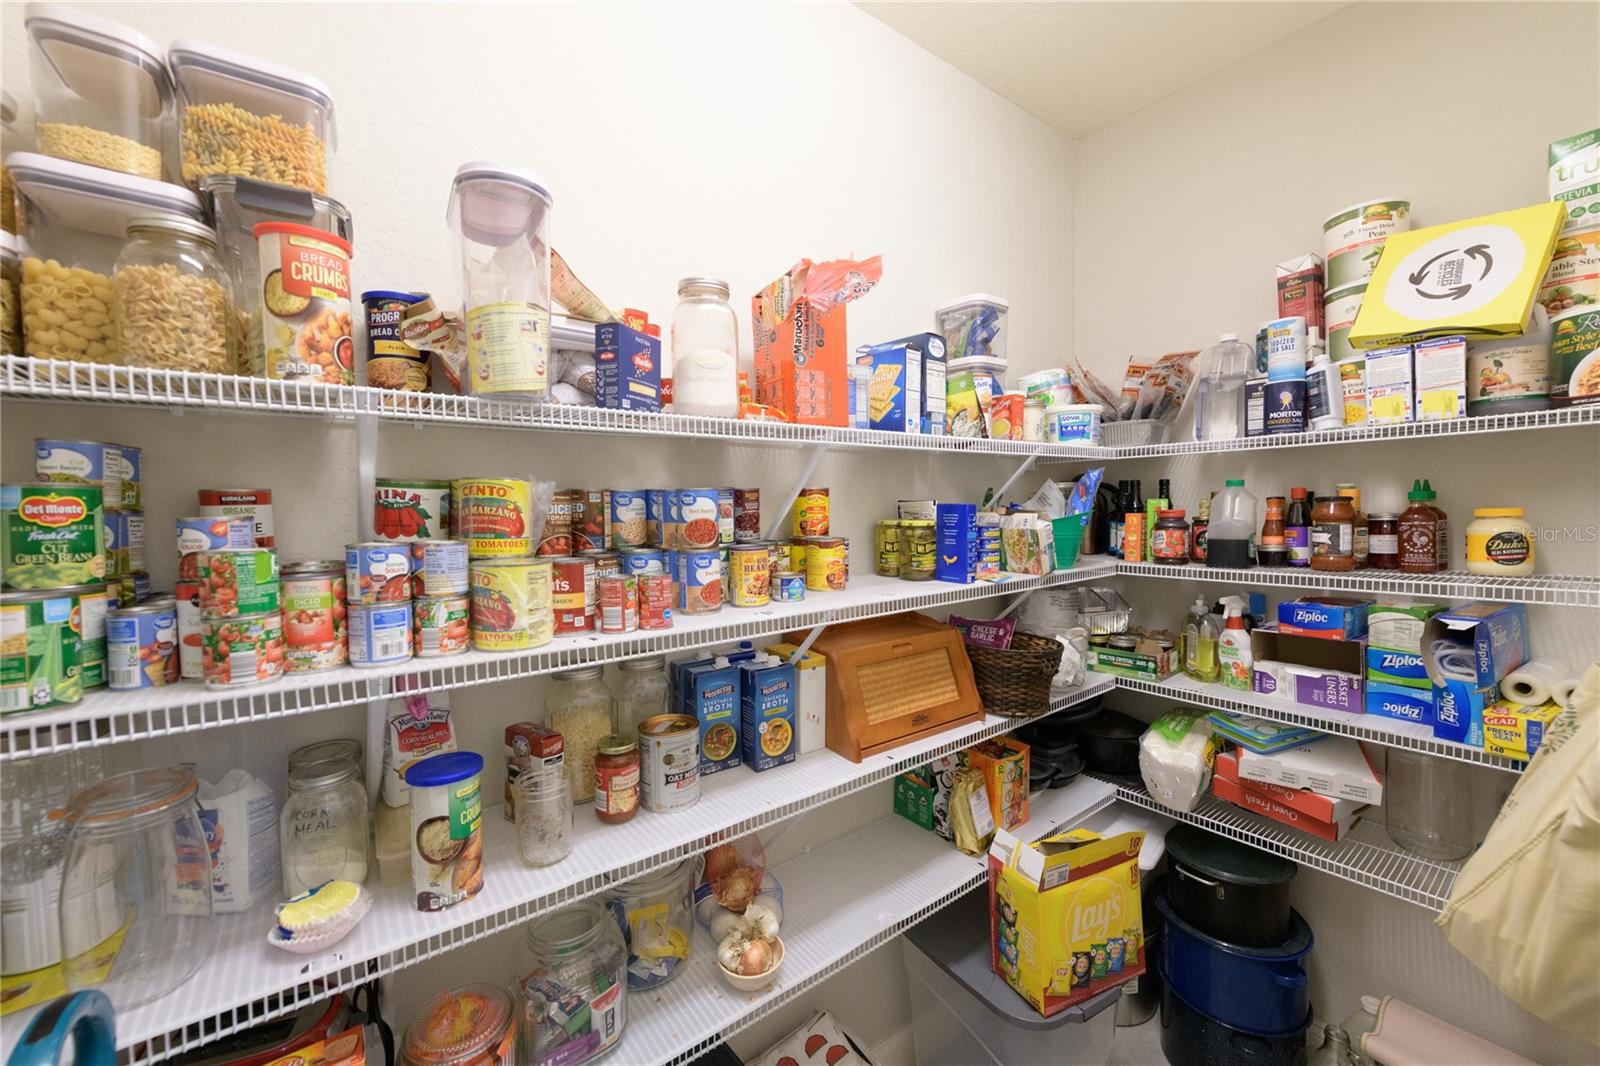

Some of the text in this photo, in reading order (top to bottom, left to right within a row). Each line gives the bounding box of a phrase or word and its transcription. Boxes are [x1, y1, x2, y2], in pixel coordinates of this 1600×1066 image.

[1556, 158, 1600, 182] tru
[1557, 188, 1594, 201] STEVIA
[300, 251, 343, 271] BREAD
[291, 261, 348, 292] CRUMBS
[1440, 260, 1456, 287] RECYCLES
[371, 311, 400, 324] PROGR
[370, 328, 392, 337] BREAD
[793, 302, 803, 354] Maruchan
[815, 339, 825, 348] 6
[1269, 410, 1302, 419] MORTON
[462, 484, 508, 498] CENTO
[24, 504, 82, 515] Del Monte
[223, 507, 257, 515] ORGANIC
[469, 504, 517, 520] MARZANO
[27, 531, 57, 541] Fresh
[40, 543, 70, 554] CUT
[475, 540, 525, 549] TOMATOES
[1488, 539, 1527, 550] Duke's
[15, 552, 94, 565] GREEN BEANS
[1295, 609, 1328, 624] Ziploc
[477, 631, 514, 641] MATOES
[970, 631, 995, 642] GARLIC
[971, 625, 999, 636] CHEESE
[1115, 656, 1135, 665] CRYSTAL
[1382, 654, 1425, 669] Ziploc
[1478, 640, 1489, 674] Ziploc
[1265, 678, 1275, 690] 10
[1326, 676, 1338, 705] LINERS
[1338, 675, 1349, 707] BASKET
[704, 697, 733, 707] VEGETABLE
[762, 698, 789, 710] BROTH
[764, 694, 786, 702] CHICKEN
[703, 702, 733, 714] BROTH
[1382, 701, 1420, 719] Ziploc
[1439, 691, 1459, 723] Ziploc
[1484, 716, 1516, 726] GLAD
[1486, 726, 1522, 738] PRESS'N
[1492, 732, 1516, 742] SEAL
[402, 736, 420, 745] CORN
[1489, 745, 1505, 754] 140
[1270, 783, 1295, 800] Oven
[1245, 793, 1298, 821] Oven Fresh
[294, 807, 329, 822] CORN
[294, 819, 337, 834] MEAL
[1072, 892, 1121, 943] Lay's
